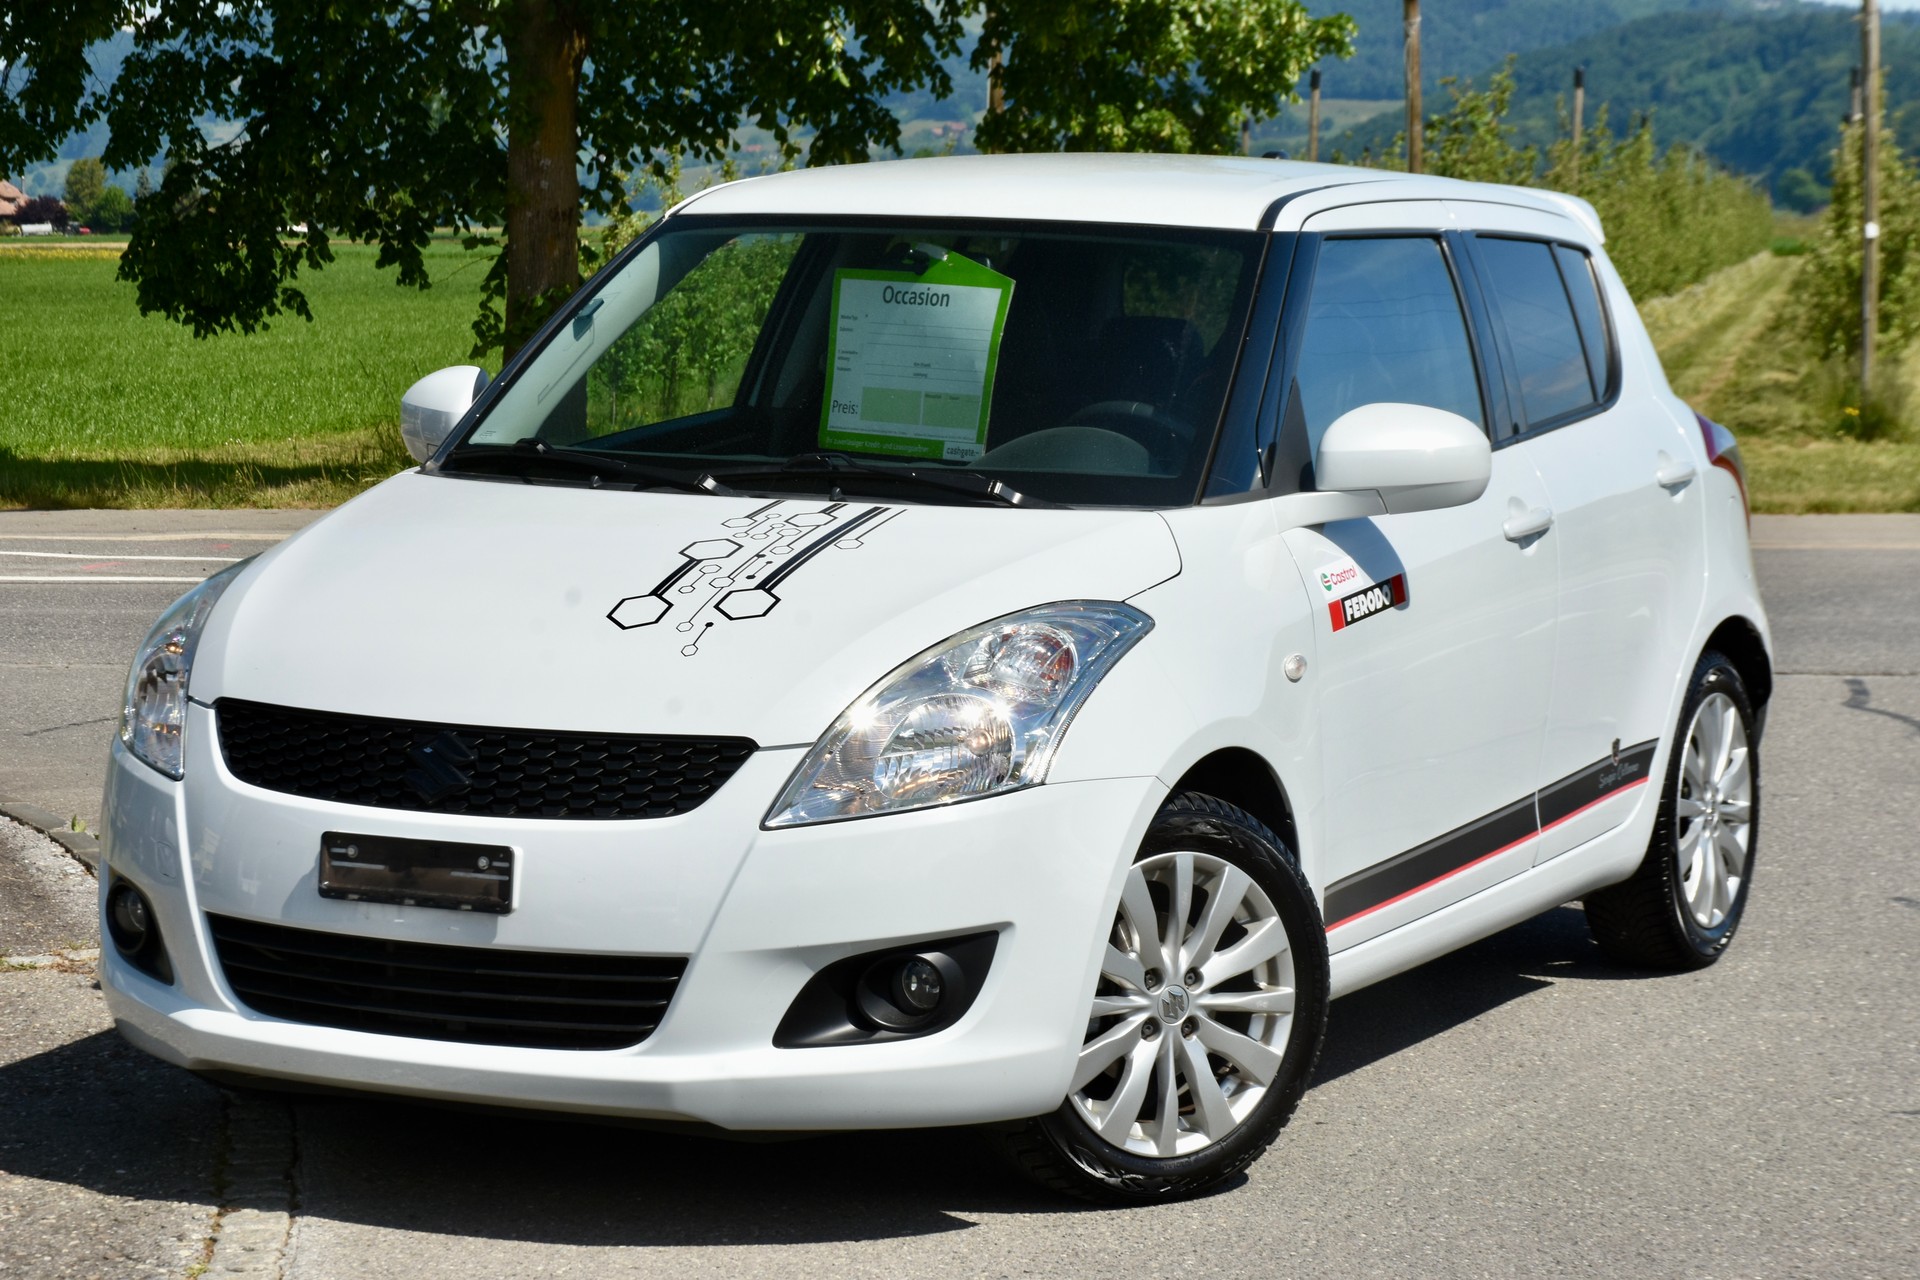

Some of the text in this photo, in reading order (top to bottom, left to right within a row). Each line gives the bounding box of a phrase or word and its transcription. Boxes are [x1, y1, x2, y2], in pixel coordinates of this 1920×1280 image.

[882, 285, 950, 307] Occasion
[831, 400, 858, 415] Preis:
[1330, 565, 1358, 585] Castrol
[1344, 584, 1391, 622] FERODO
